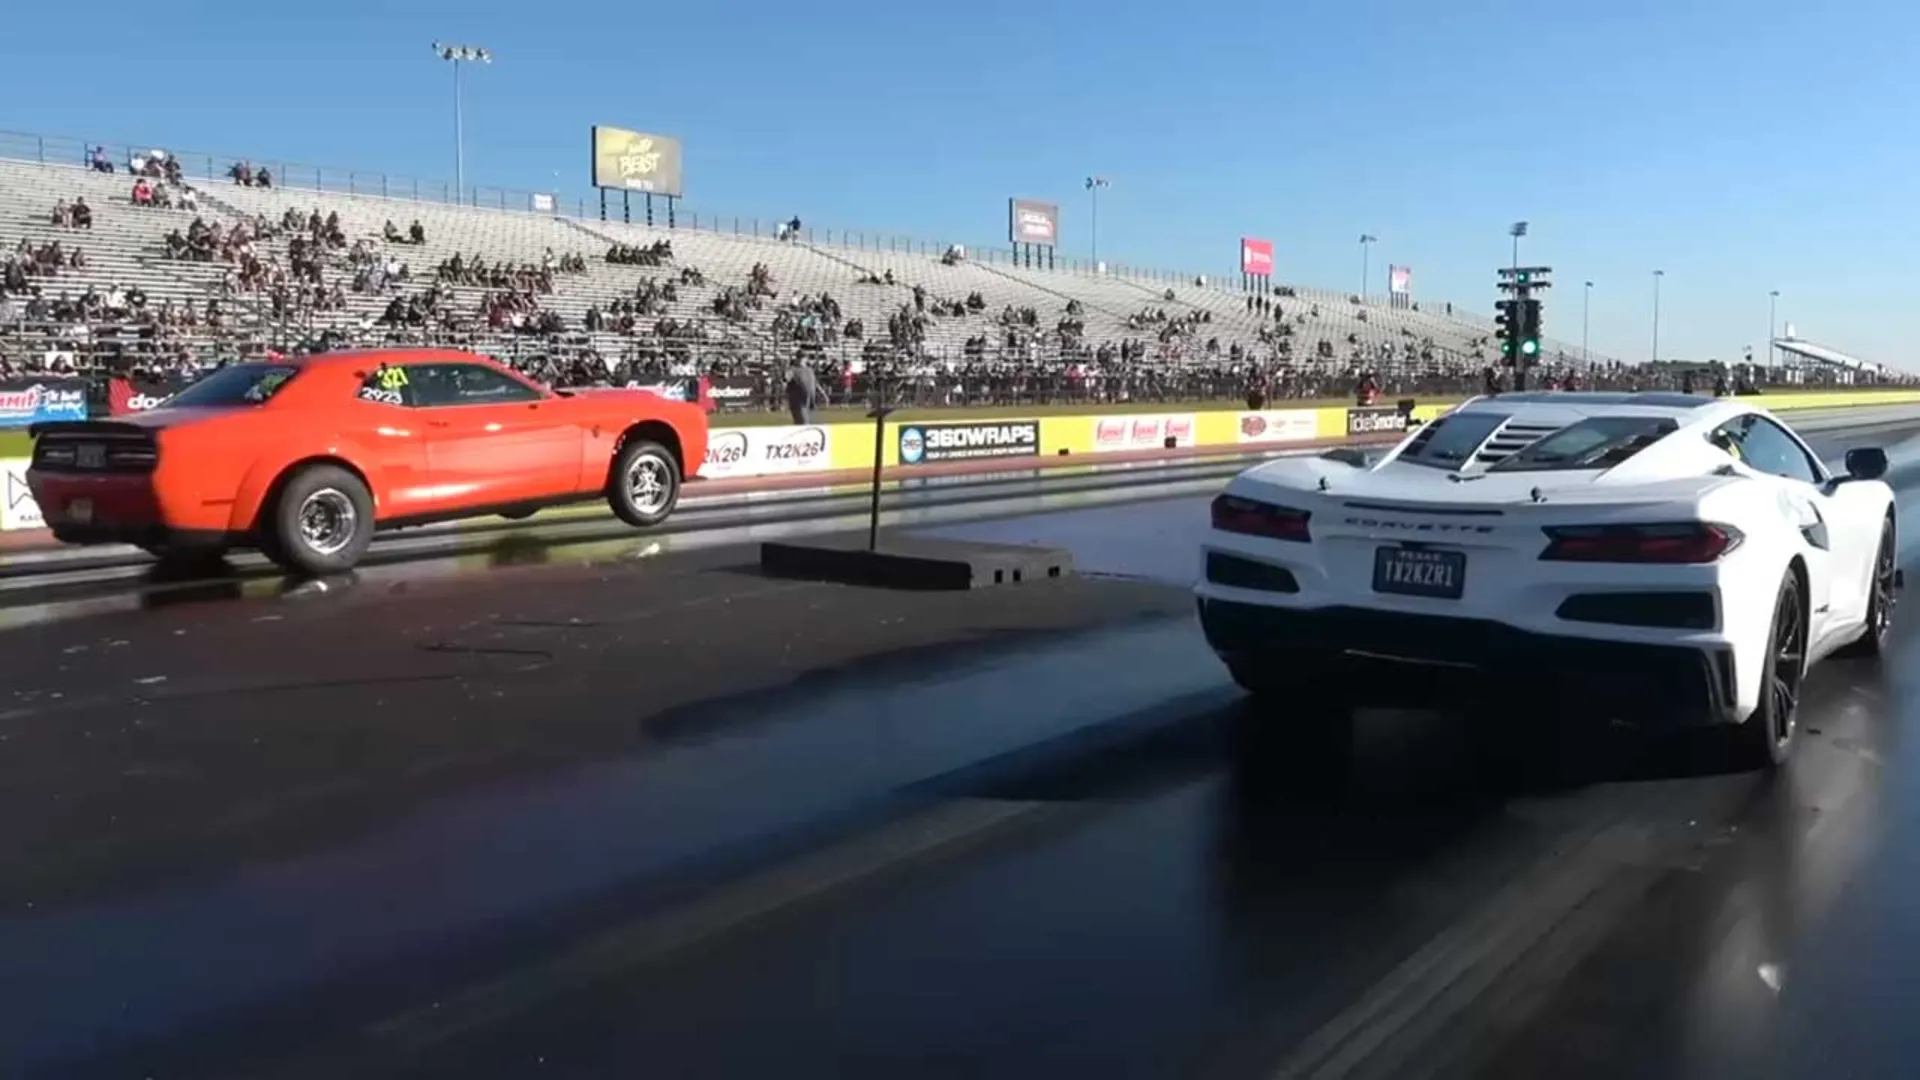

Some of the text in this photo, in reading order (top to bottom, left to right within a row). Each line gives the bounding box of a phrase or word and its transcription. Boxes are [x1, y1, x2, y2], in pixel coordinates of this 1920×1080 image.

[925, 425, 1035, 448] 360WRAPS
[765, 442, 819, 460] TX2K26
[1345, 517, 1495, 533] CORVETTE
[1398, 551, 1443, 561] TEXAS
[1385, 561, 1453, 587] TX2KZR1
